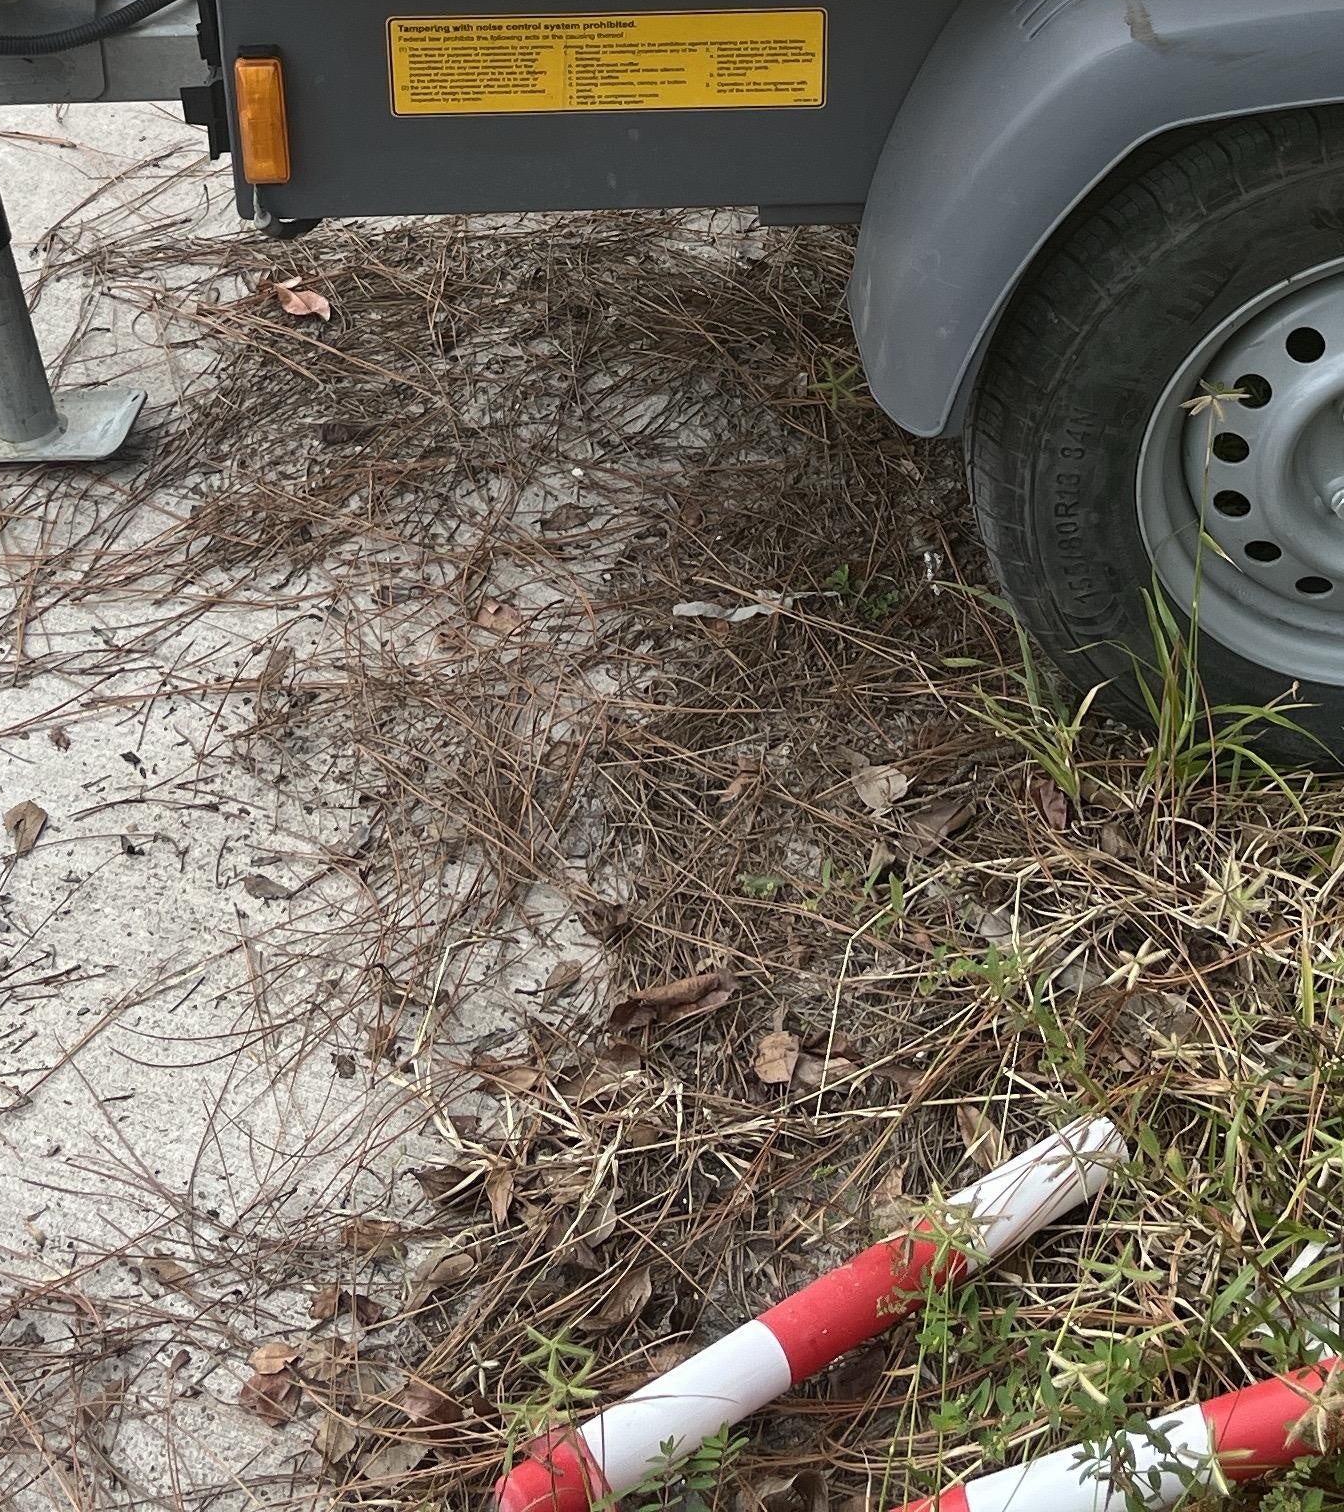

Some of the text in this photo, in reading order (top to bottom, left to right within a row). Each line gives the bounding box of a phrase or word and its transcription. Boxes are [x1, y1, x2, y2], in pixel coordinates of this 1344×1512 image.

[398, 24, 449, 33] Tampering
[506, 22, 540, 30] control
[543, 22, 579, 31] system
